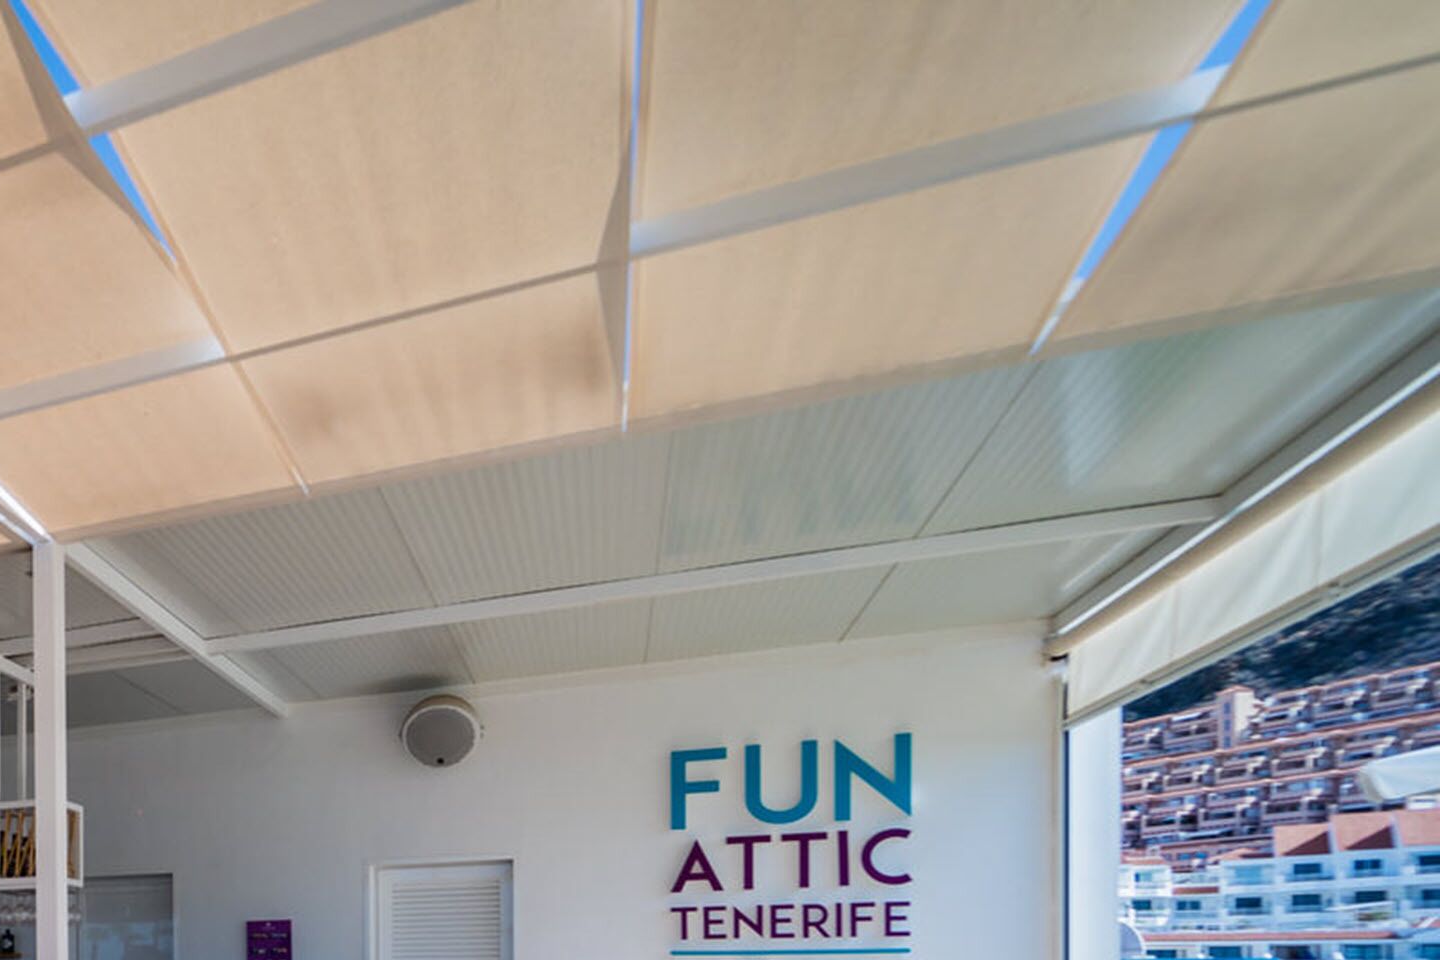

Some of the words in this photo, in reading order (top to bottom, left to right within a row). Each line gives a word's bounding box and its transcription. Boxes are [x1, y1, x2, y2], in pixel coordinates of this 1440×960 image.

[670, 732, 912, 830] FUN
[670, 828, 913, 893] ATTIC
[670, 901, 912, 940] TENERIFE
